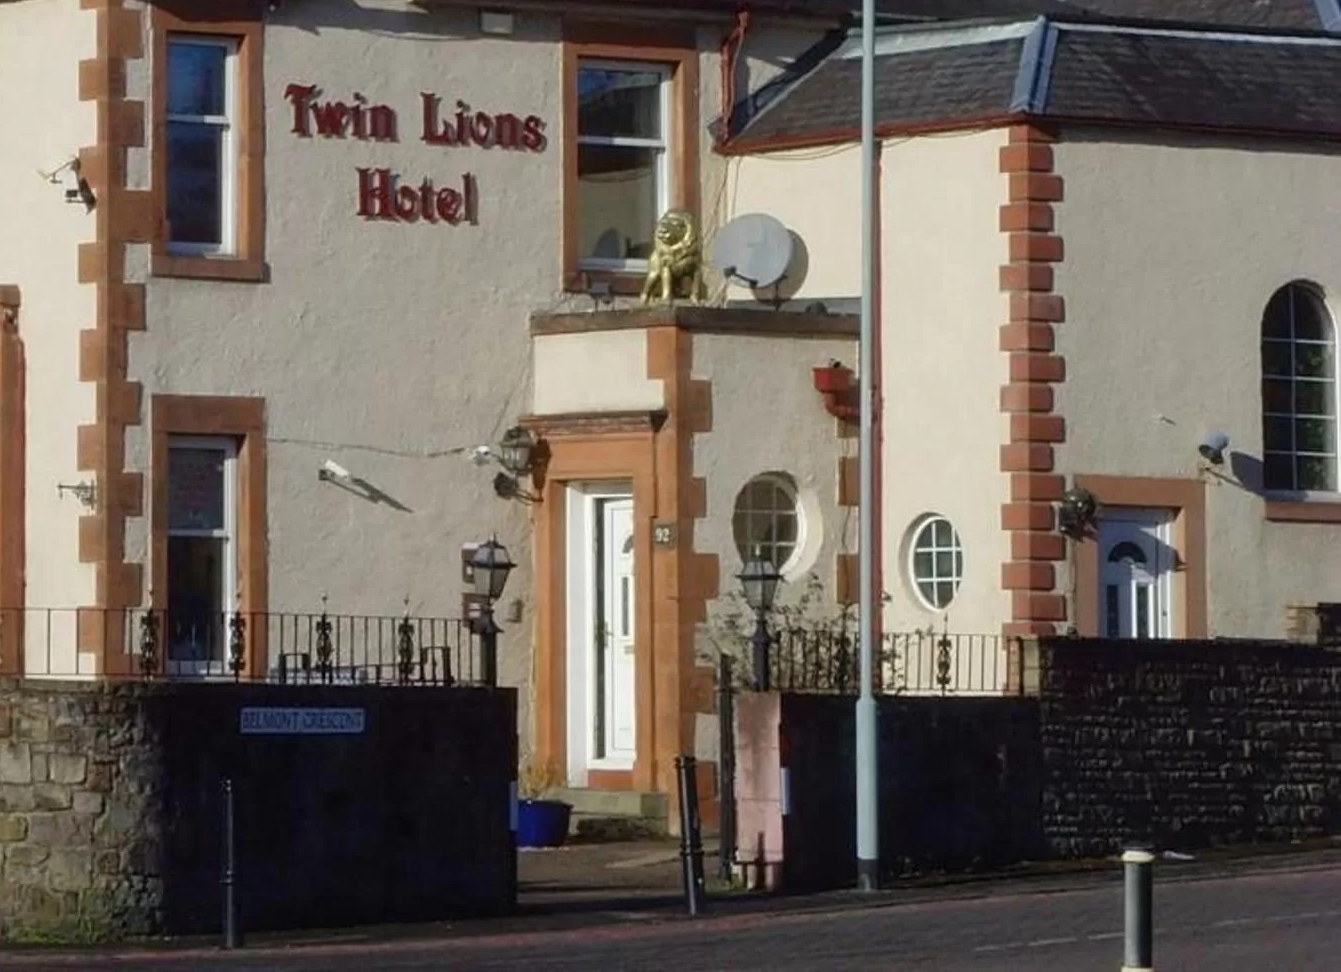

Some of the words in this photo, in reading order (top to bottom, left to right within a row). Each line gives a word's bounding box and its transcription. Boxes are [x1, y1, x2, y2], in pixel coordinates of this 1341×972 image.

[284, 83, 400, 144] Twin
[420, 91, 548, 153] Lions
[355, 167, 479, 227] Hotel
